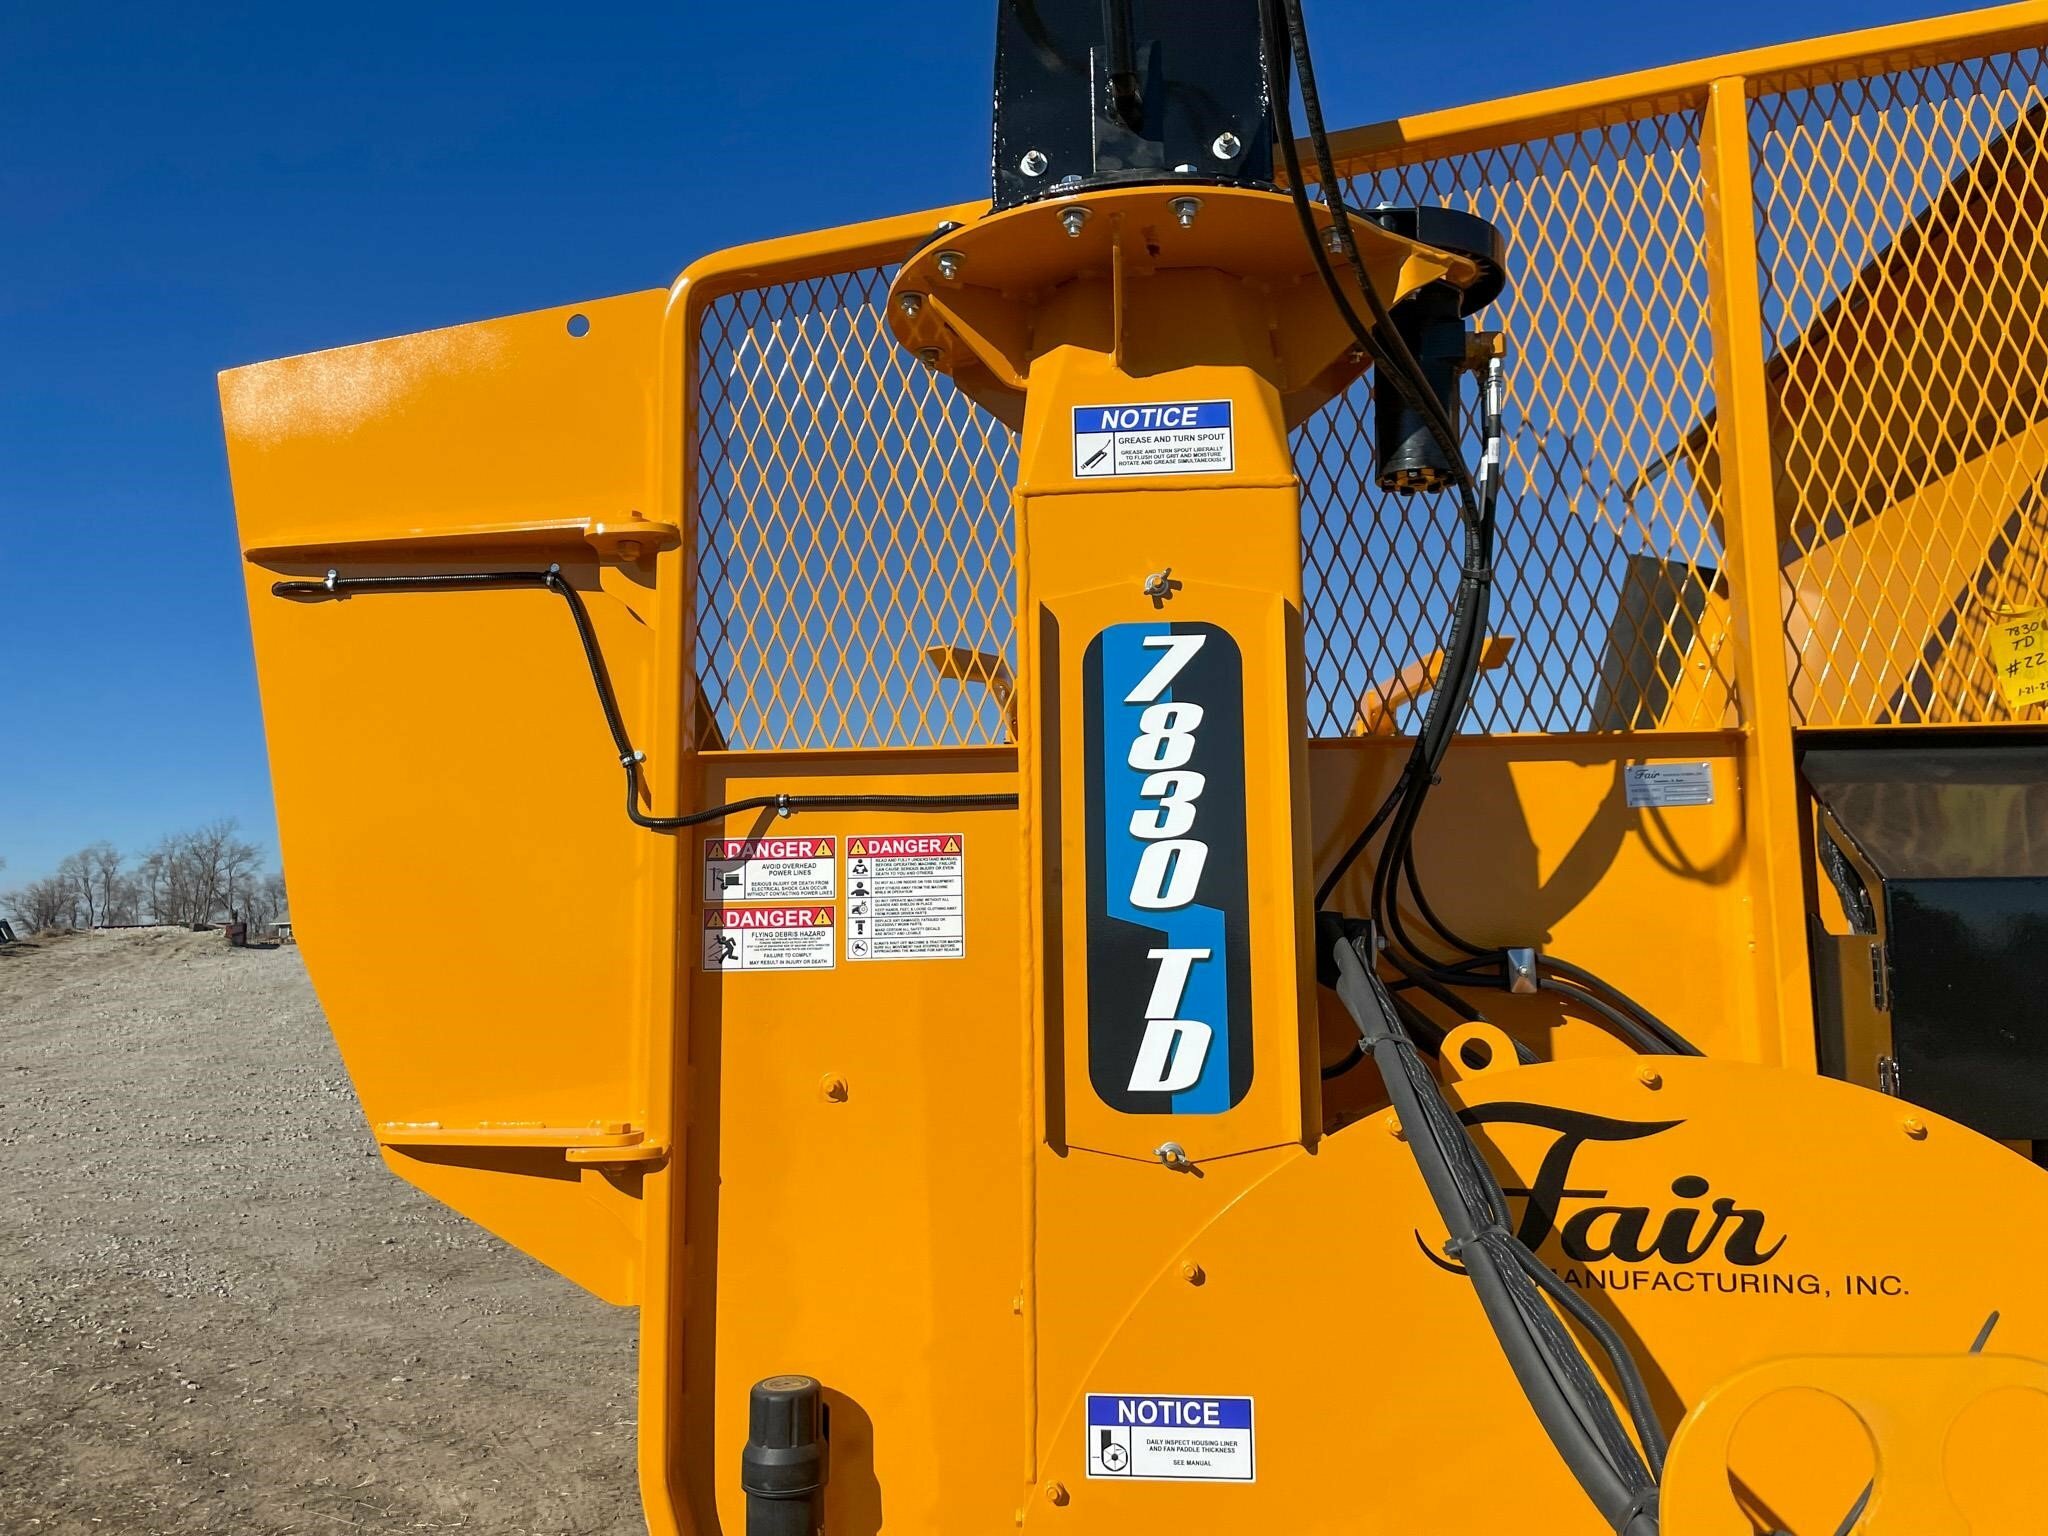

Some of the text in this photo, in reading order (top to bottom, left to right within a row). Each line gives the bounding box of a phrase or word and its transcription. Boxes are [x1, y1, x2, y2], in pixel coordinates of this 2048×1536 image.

[1101, 407, 1199, 429] NOTICE
[1118, 436, 1151, 444] GREASE
[1172, 434, 1196, 443] TURN
[1197, 433, 1225, 442] SPOUT
[2004, 621, 2039, 637] 7830
[2011, 635, 2035, 651] TD
[1124, 634, 1209, 909] 7830
[1634, 769, 1660, 780] Fair
[727, 841, 813, 859] DANGER
[868, 839, 942, 855] DANGER
[782, 862, 817, 870] OVERHEAD
[726, 910, 813, 928] DANGER
[1127, 948, 1212, 1092] TD
[1415, 1101, 1788, 1276] Fair
[1538, 1267, 1910, 1298] ANUFACTURING, INC.
[1118, 1400, 1220, 1425] NOTICE
